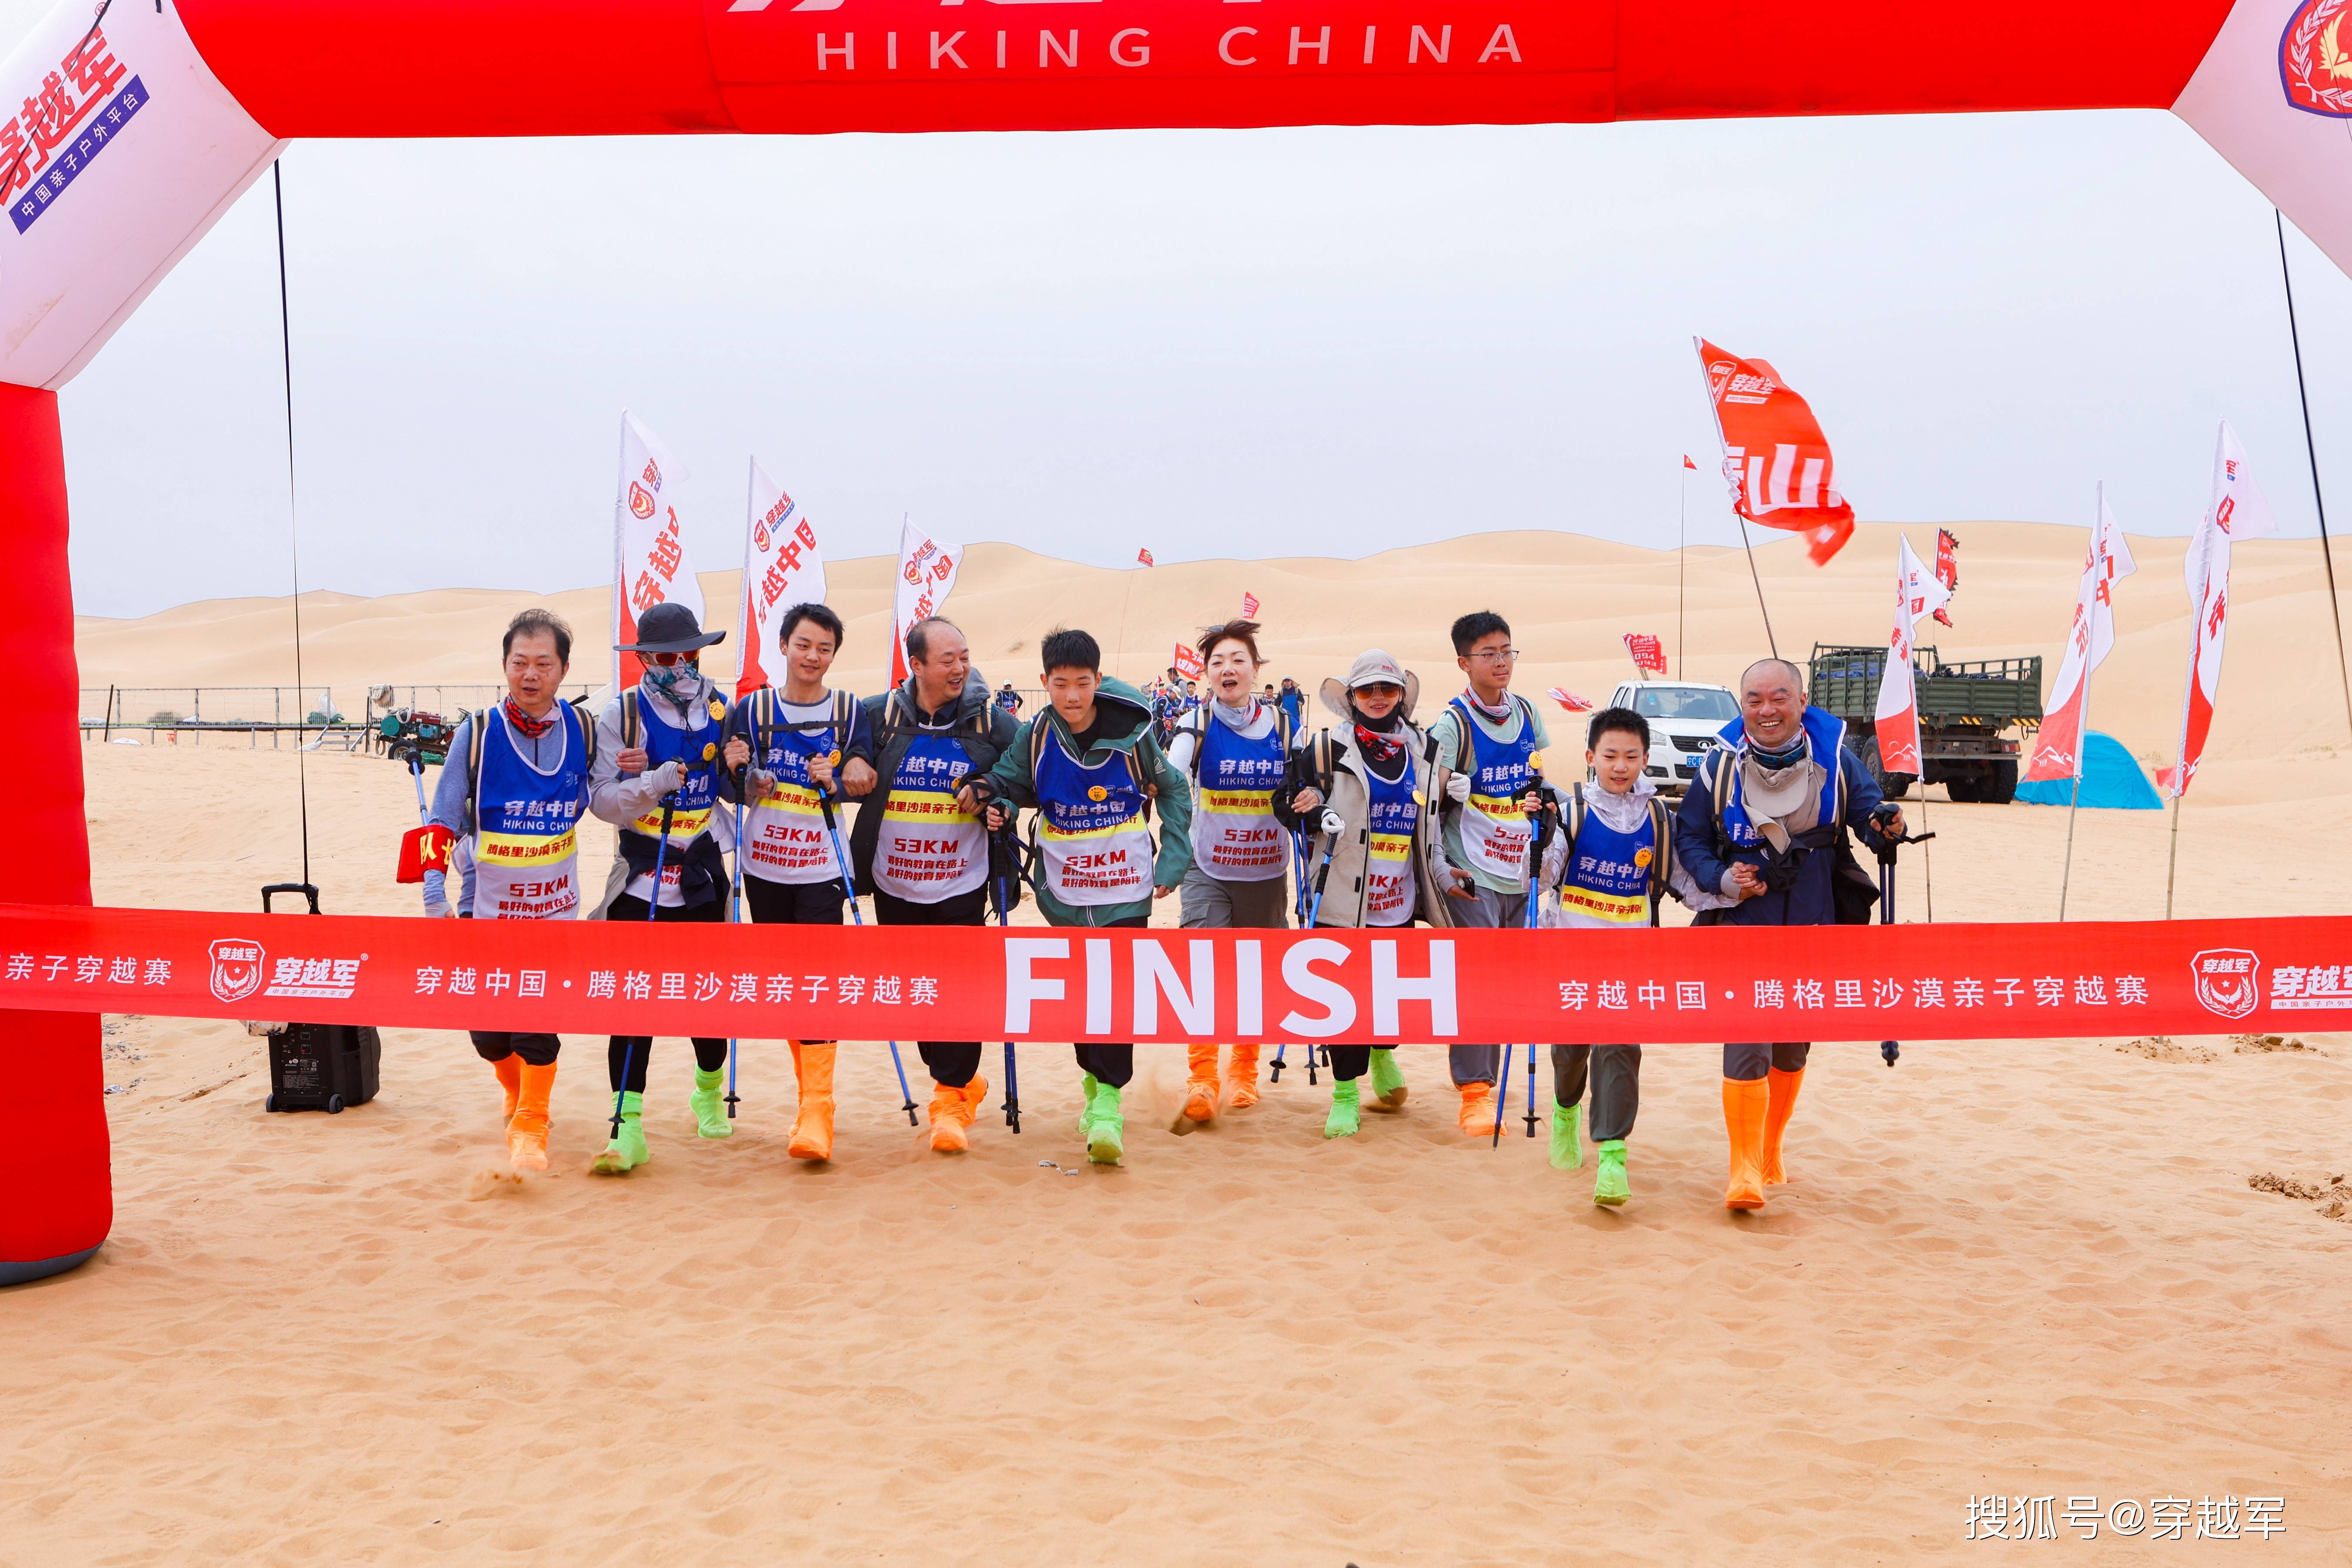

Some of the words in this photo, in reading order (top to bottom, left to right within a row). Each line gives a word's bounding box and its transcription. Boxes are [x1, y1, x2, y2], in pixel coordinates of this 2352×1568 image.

[816, 28, 1151, 70] HIKING
[1218, 24, 1523, 65] CHINA
[21, 93, 138, 217] 中国亲子户外平台
[1219, 759, 1284, 775] 穿越中国
[1219, 777, 1255, 786] HIKING
[1054, 801, 1125, 817] 穿越中国
[503, 819, 545, 831] HIKING
[1055, 816, 1091, 828] HIKING
[1095, 813, 1130, 827] CHINA
[764, 824, 821, 843] 53KM
[1224, 828, 1278, 842] 53KM
[752, 840, 828, 857] 最好的教育在路上
[894, 838, 958, 854] 53KM
[1213, 844, 1282, 856] 最好的教育在路上
[751, 851, 828, 868] 最好的教育是陪伴
[887, 855, 968, 869] 最好的教育在路上
[1064, 849, 1126, 869] 53KM
[1212, 854, 1283, 867] 最好的教育是陪伴
[509, 874, 568, 897] 53KM
[1061, 875, 1141, 888] 最好的教育是陪伴
[1578, 872, 1614, 888] HIKING
[1617, 881, 1641, 891] CHINA
[498, 891, 577, 913] 最好的教育在路上
[218, 947, 258, 962] 穿越军
[5, 952, 171, 986] 亲子穿越赛
[271, 957, 360, 988] 穿越军
[2201, 958, 2252, 973] 穿越军
[271, 988, 347, 998] 中国亲子户外平台
[1004, 937, 1459, 1037] FINISH
